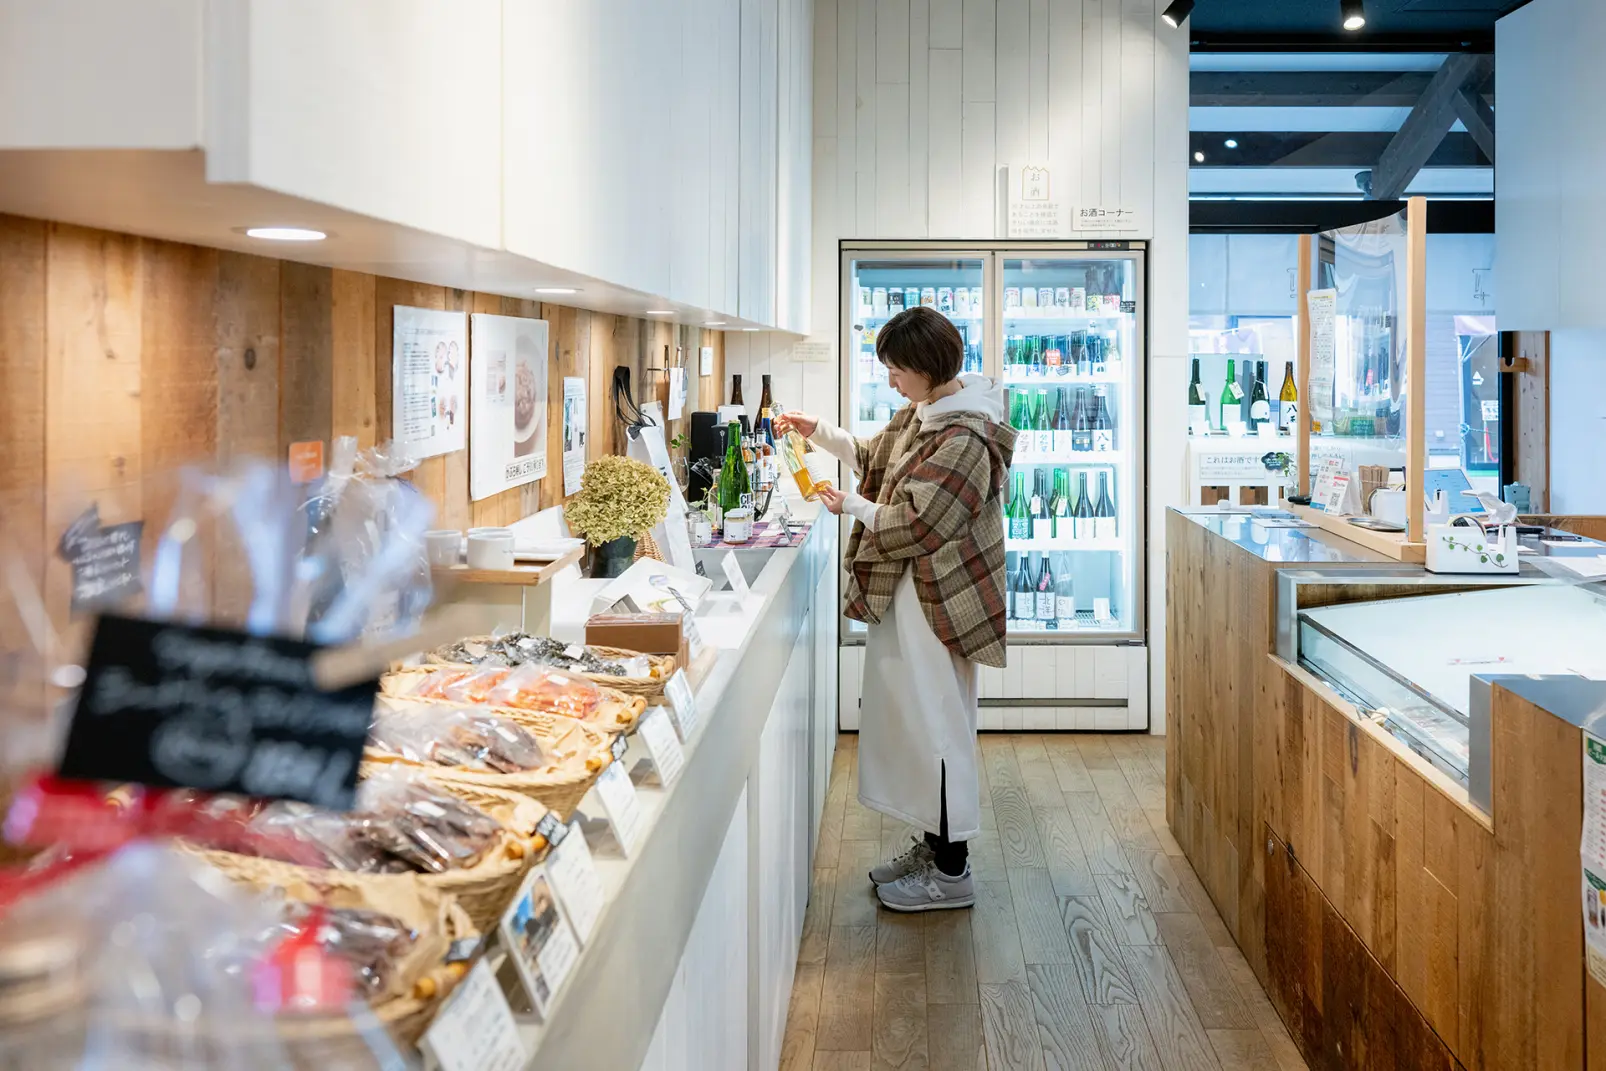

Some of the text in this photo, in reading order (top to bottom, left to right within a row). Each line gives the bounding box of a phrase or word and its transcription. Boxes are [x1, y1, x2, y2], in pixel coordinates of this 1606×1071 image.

[1080, 208, 1133, 217] お酒コーナー
[1206, 456, 1261, 464] これはお酒です
